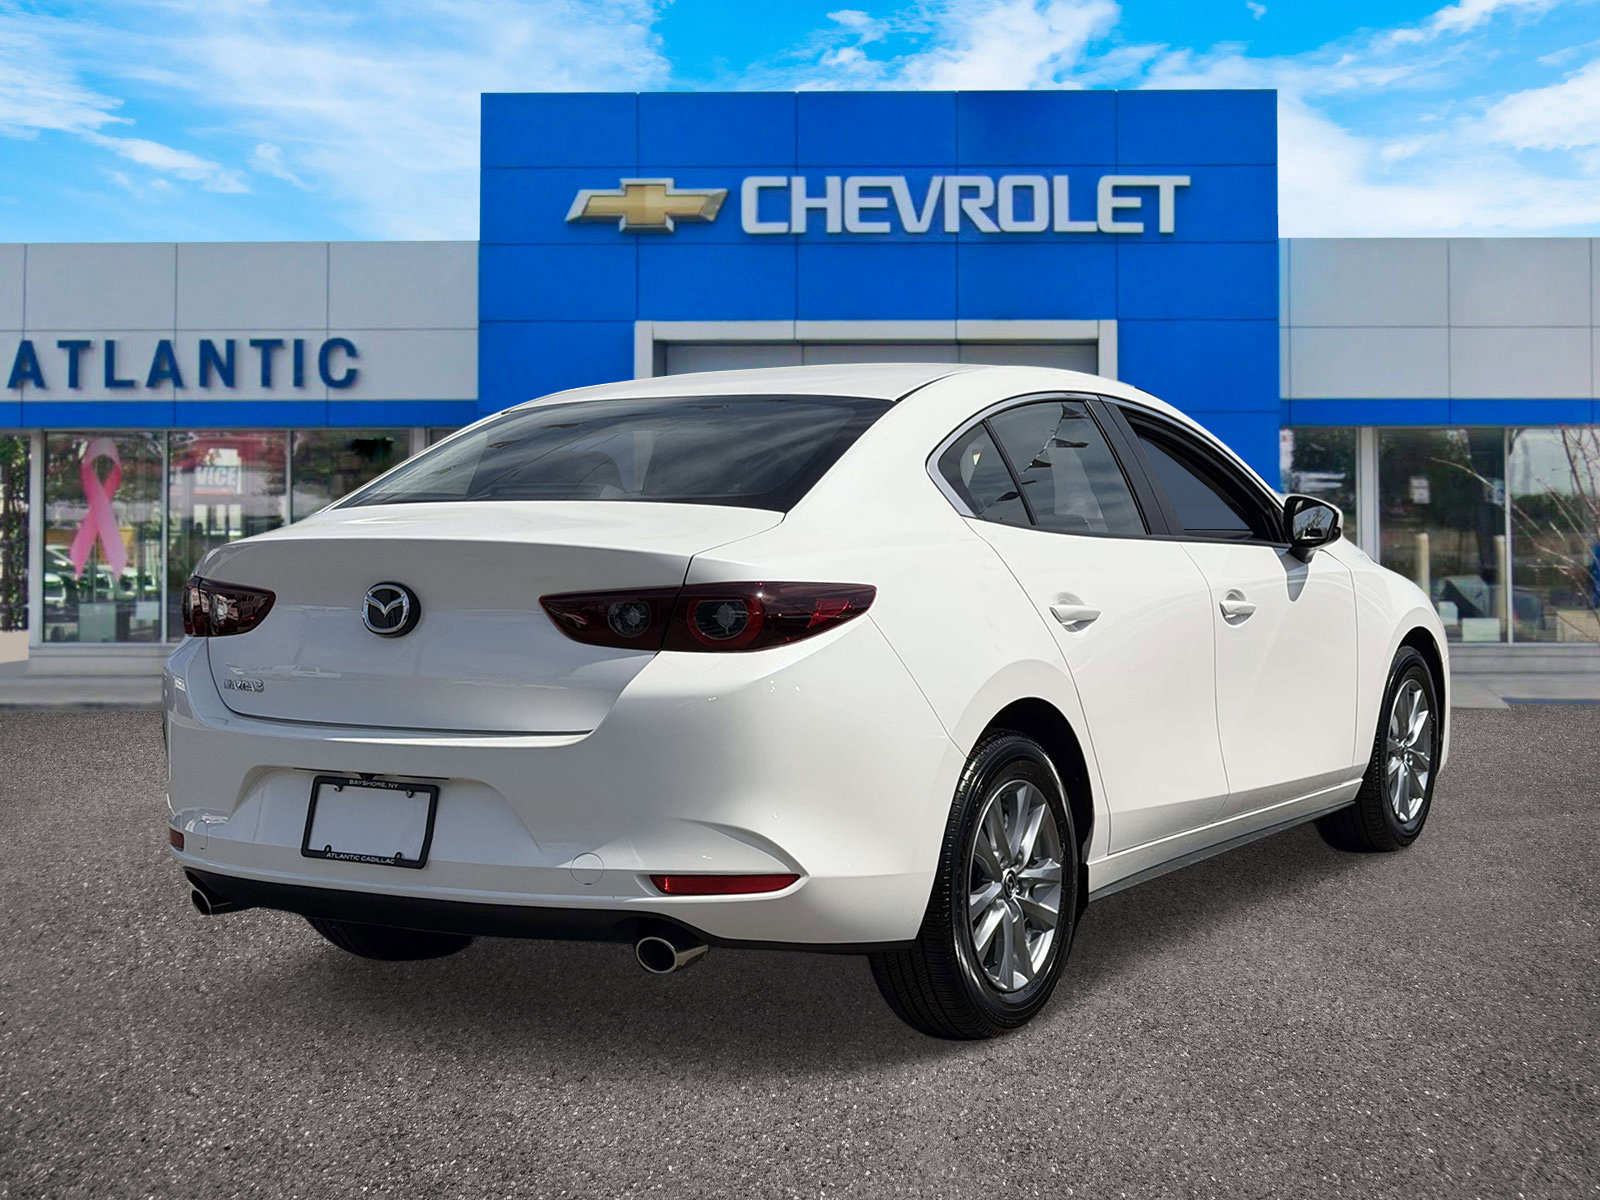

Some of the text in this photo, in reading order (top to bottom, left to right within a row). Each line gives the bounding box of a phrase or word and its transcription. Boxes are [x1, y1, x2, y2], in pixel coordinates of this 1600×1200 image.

[740, 175, 1191, 234] CHEVROLET
[7, 337, 360, 389] ATLANTIC
[326, 852, 395, 865] ATLANTIC CADILLAC
